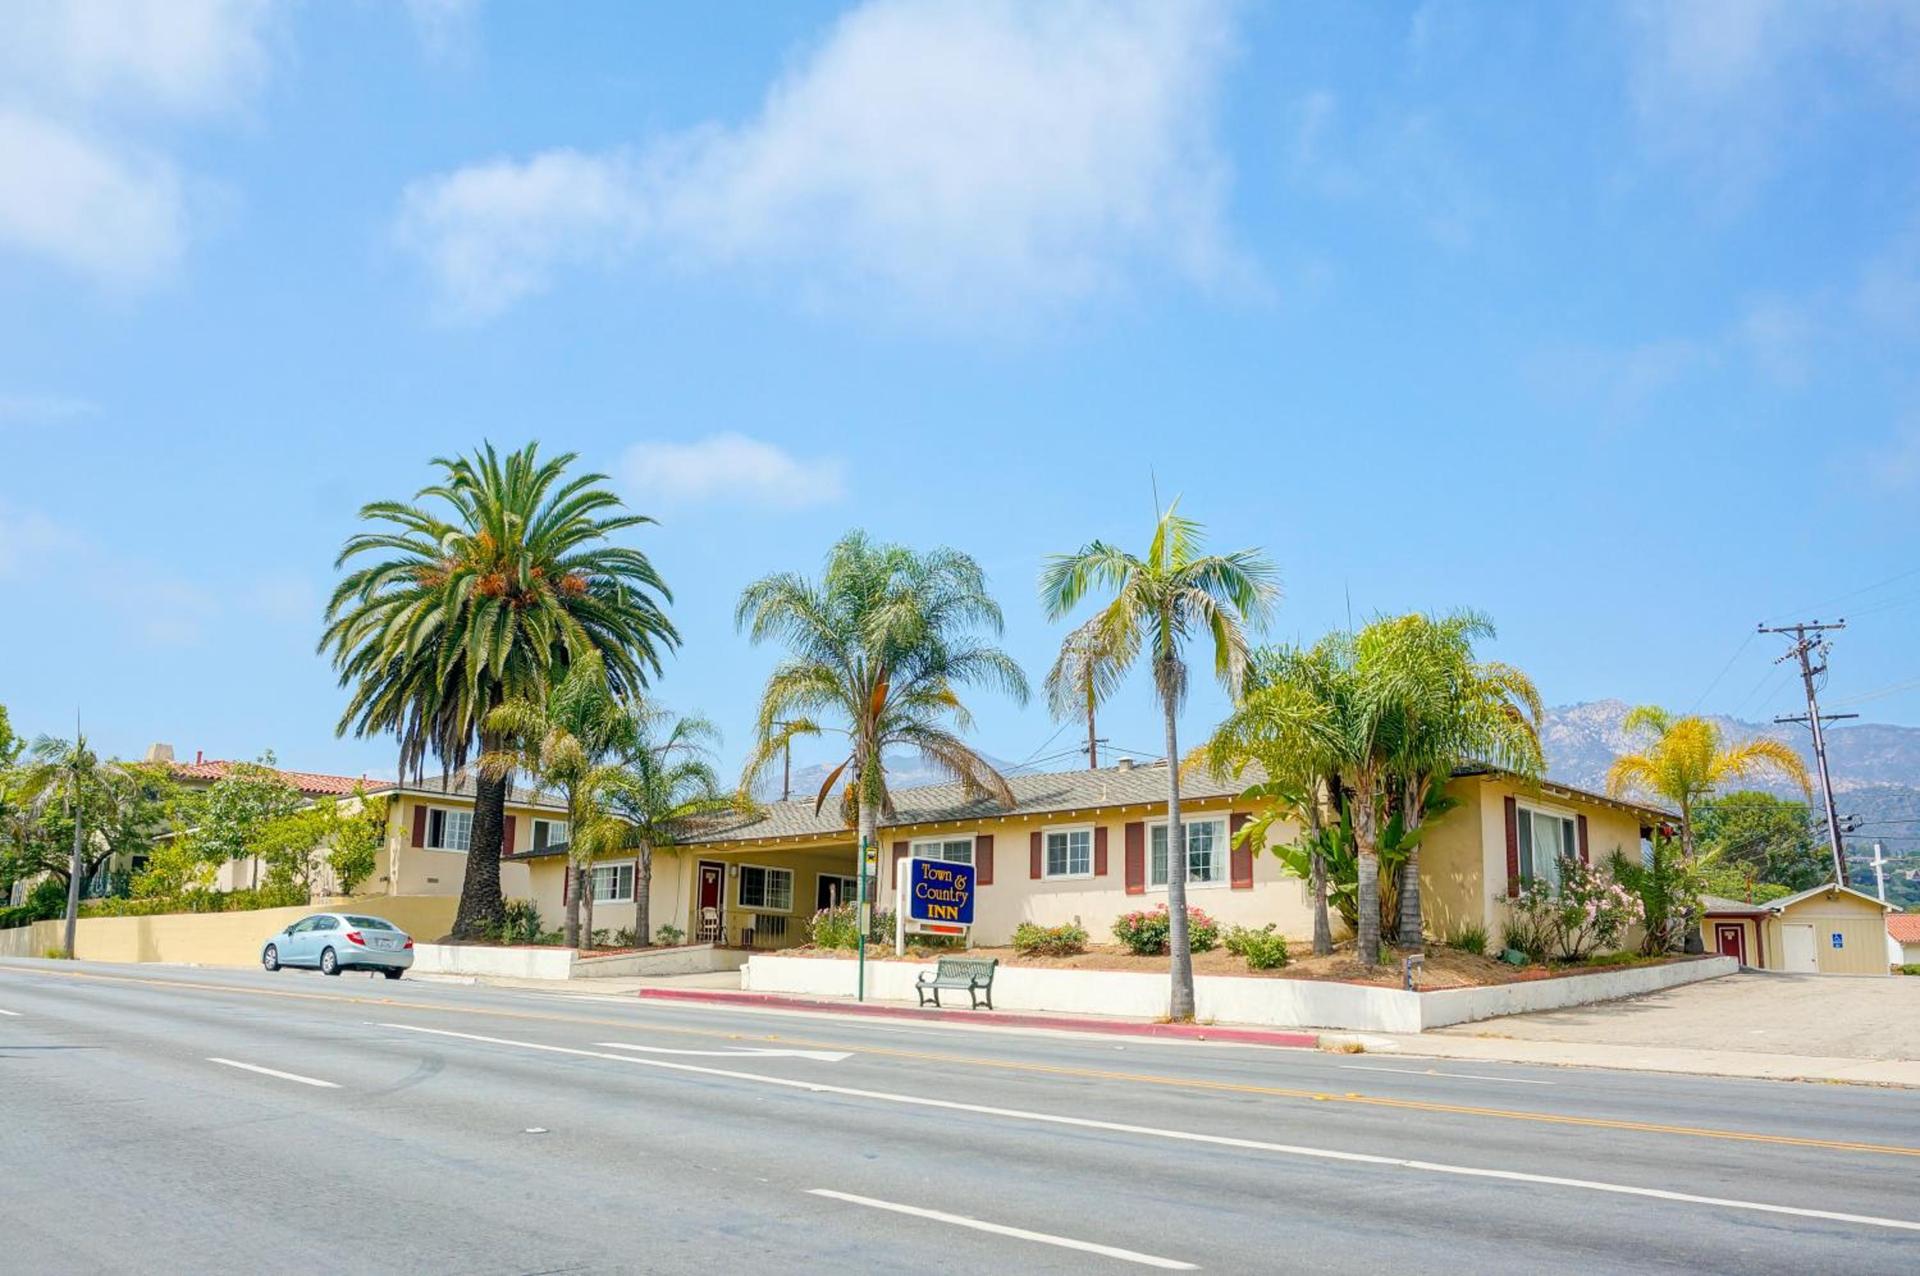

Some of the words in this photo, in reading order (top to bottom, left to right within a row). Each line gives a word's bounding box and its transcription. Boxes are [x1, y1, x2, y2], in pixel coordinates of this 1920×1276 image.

[922, 863, 952, 882] Town
[955, 875, 967, 890] &
[916, 883, 968, 908] Country
[928, 904, 958, 920] INN
